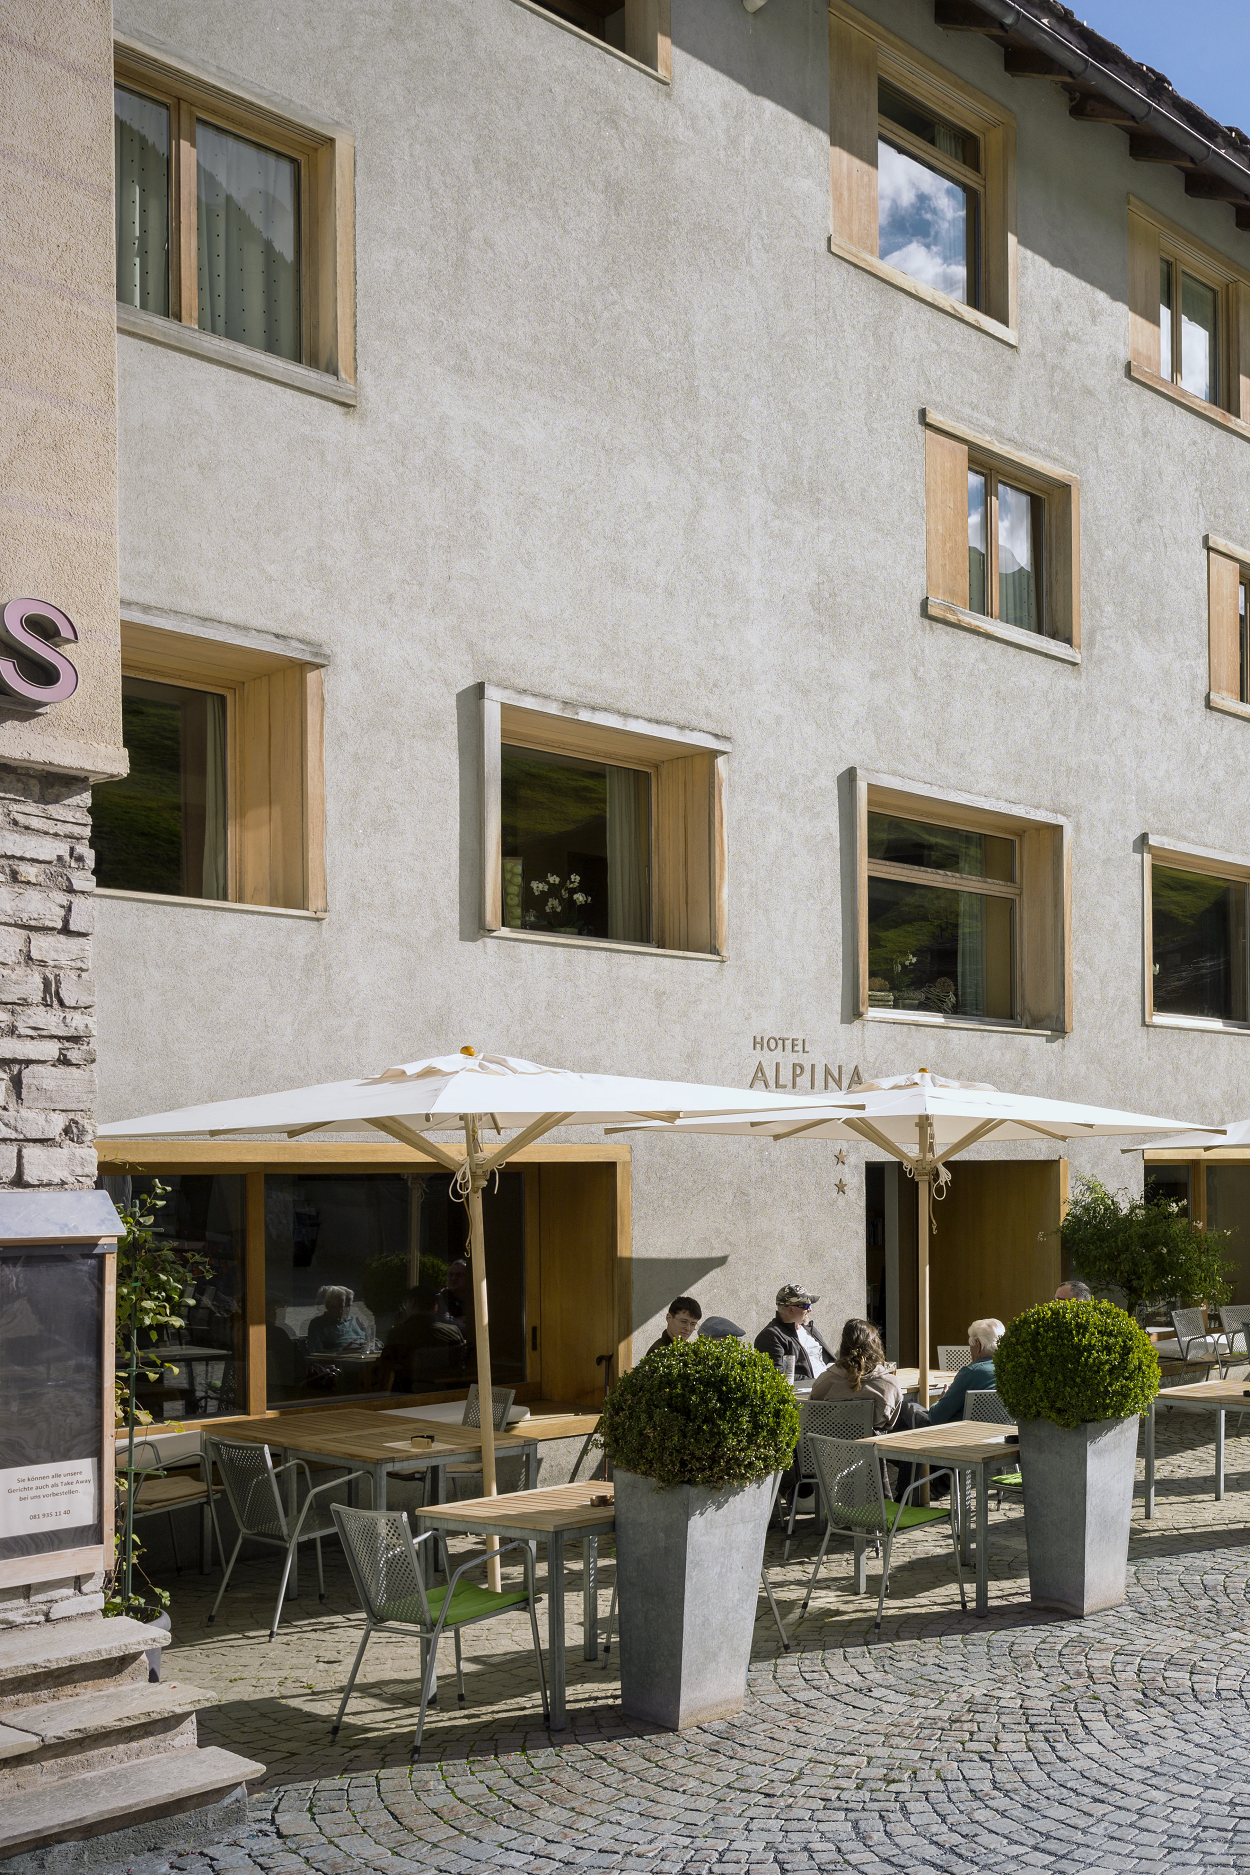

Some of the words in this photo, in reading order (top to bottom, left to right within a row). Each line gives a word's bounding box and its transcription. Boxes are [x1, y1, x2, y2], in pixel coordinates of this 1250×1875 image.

[752, 1035, 810, 1054] HOTEL
[749, 1060, 864, 1091] ALPINA
[27, 1474, 50, 1482] können
[63, 1470, 83, 1478] unsere
[7, 1485, 34, 1494] Gerichte
[35, 1483, 50, 1491] auch
[75, 1478, 92, 1486] Away
[42, 1488, 81, 1499] vorbestellen.
[29, 1513, 41, 1521] 081
